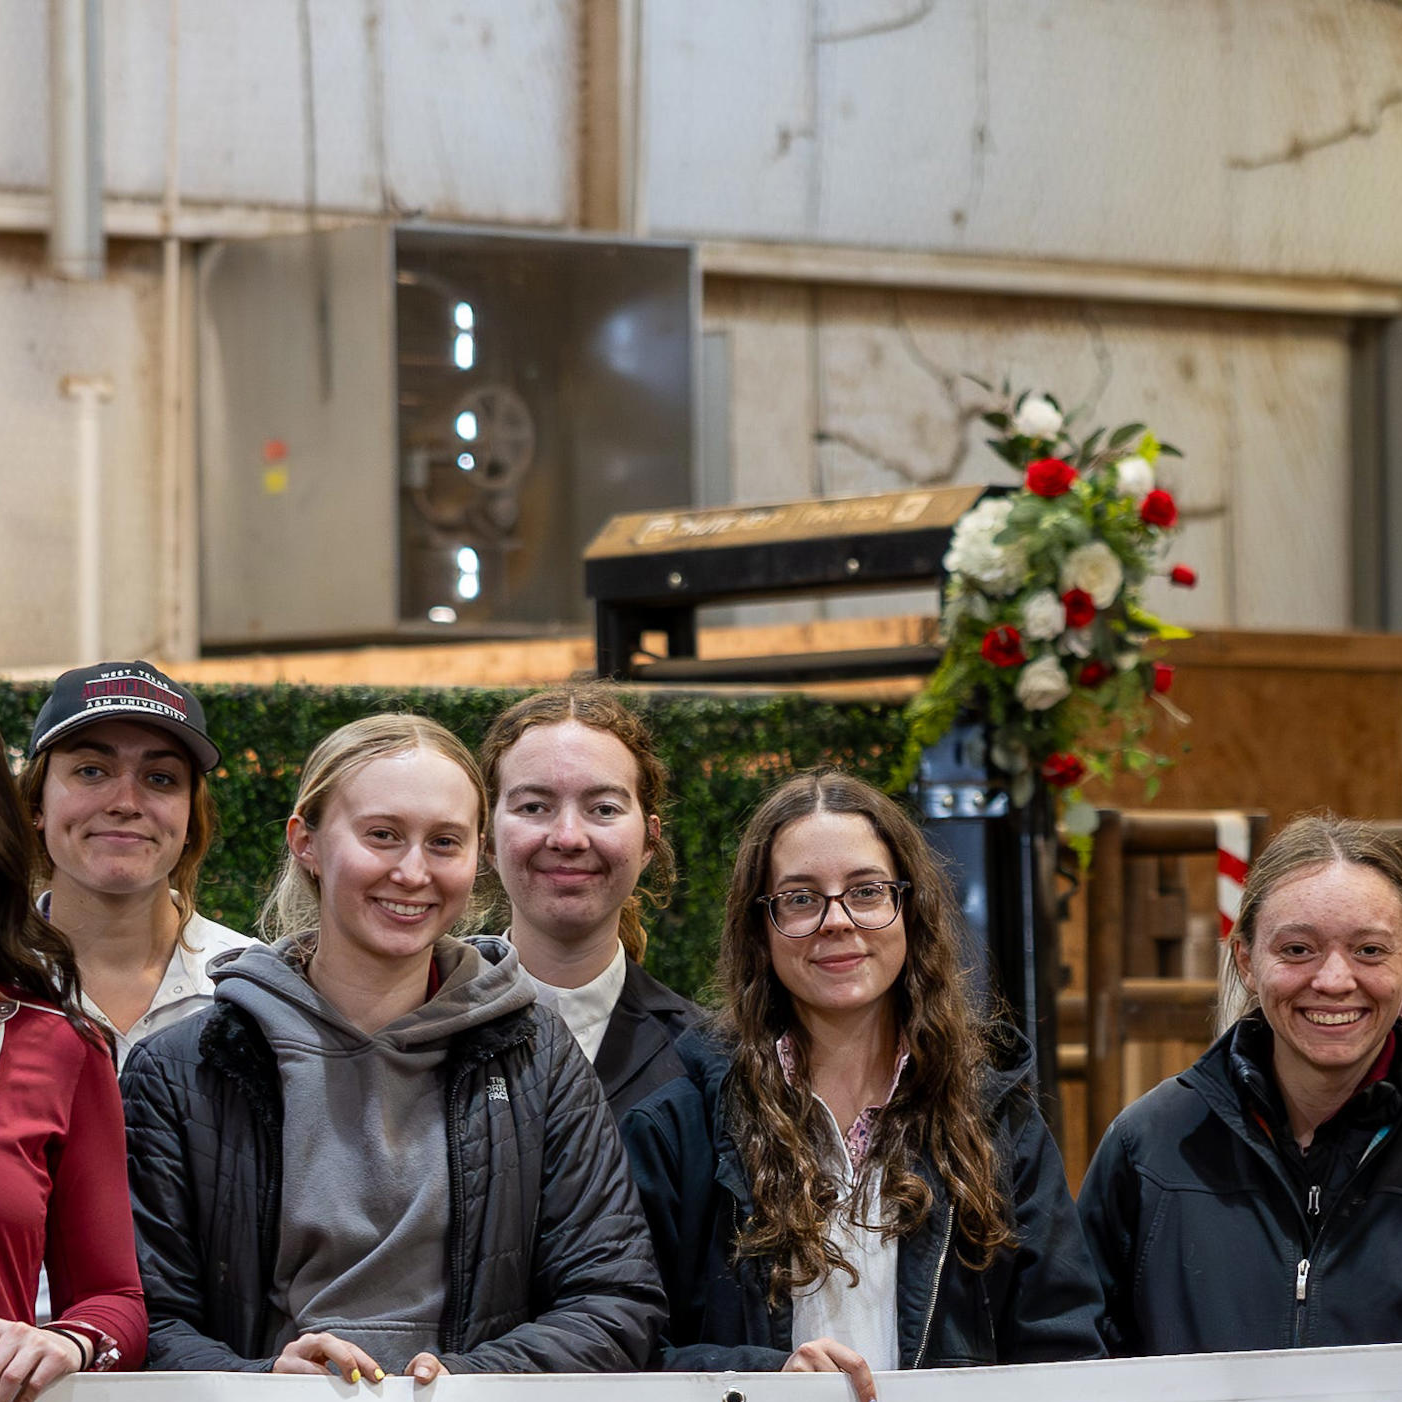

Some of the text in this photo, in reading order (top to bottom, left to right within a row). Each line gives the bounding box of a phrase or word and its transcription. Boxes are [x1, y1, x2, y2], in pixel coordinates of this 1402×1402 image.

[101, 669, 170, 690] WEST TEXAS
[120, 698, 186, 722] UNIVERSITY
